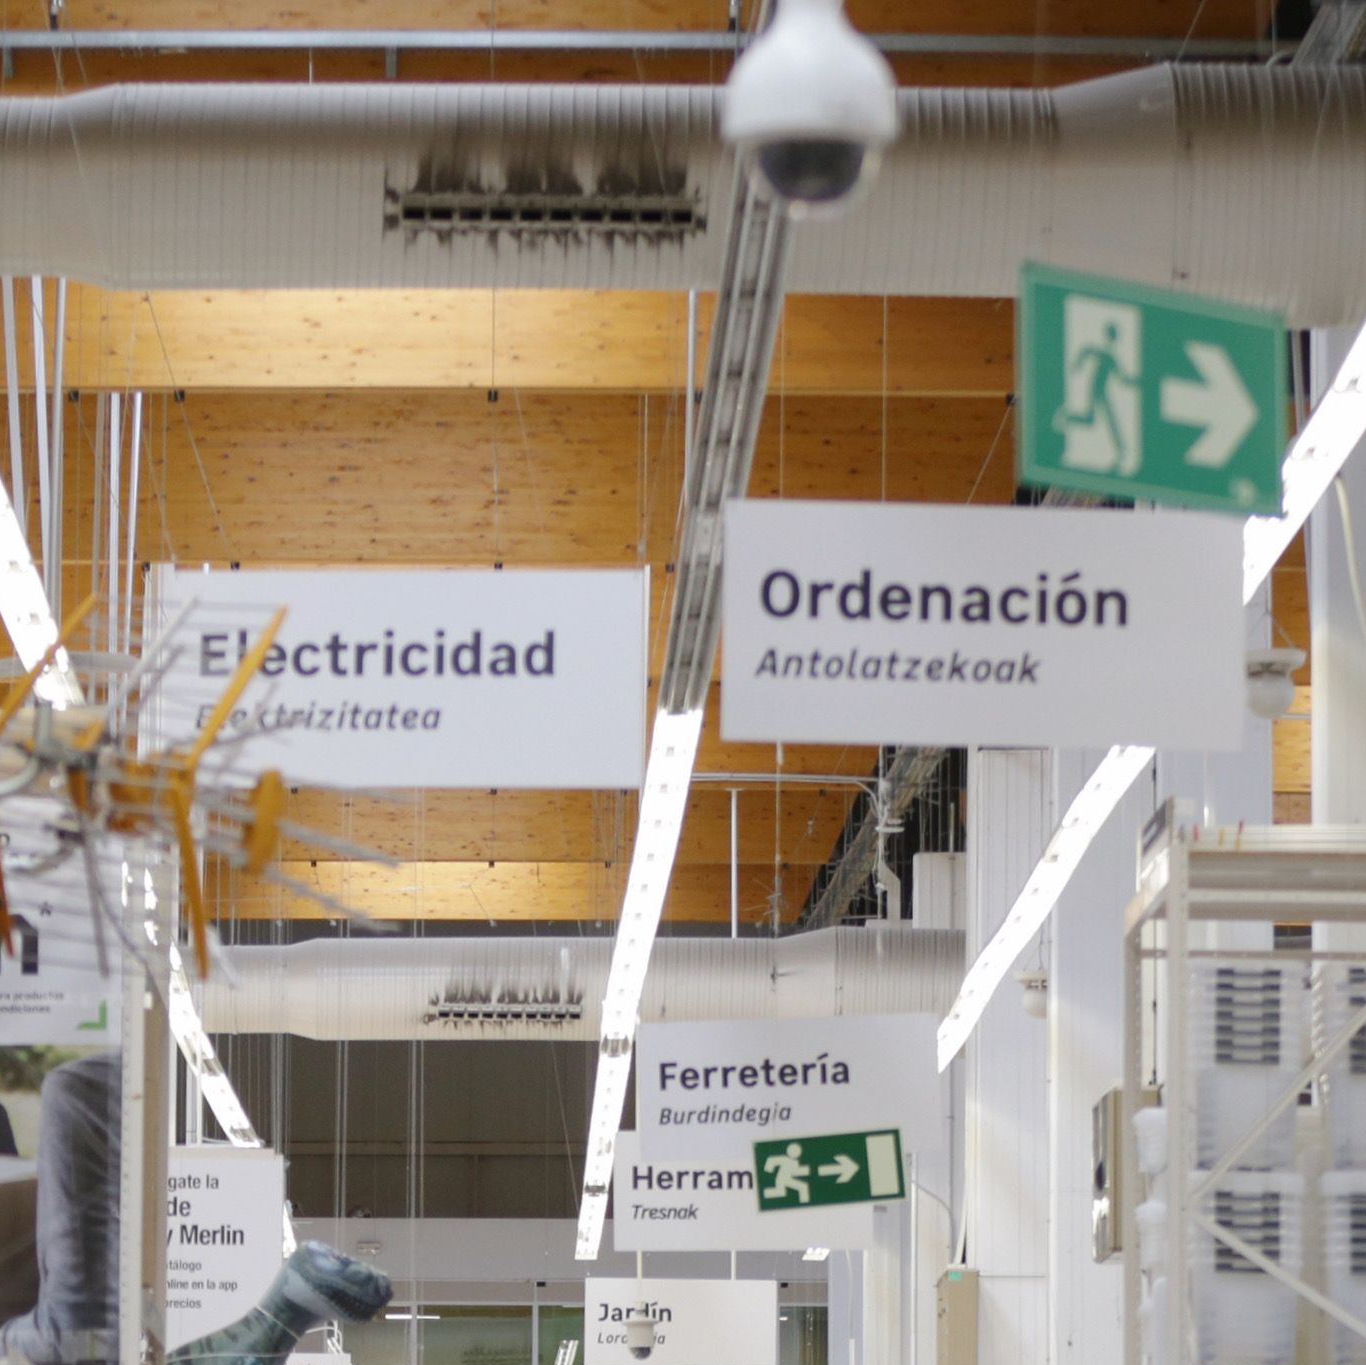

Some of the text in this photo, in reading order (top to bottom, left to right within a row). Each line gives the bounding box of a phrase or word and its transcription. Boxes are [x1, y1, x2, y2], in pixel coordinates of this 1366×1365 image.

[759, 569, 1128, 628] Ordenación
[199, 629, 556, 676] Electricidad
[755, 647, 1040, 685] Antolatzekoak
[195, 701, 441, 731] Eektrizitatea
[13, 991, 64, 1002] productos
[659, 1053, 850, 1091] Ferretería
[659, 1103, 792, 1127] Burdindegia
[206, 1174, 219, 1190] la
[632, 1165, 753, 1190] Herram
[632, 1204, 698, 1220] Tresnak
[180, 1224, 244, 1246] Merlin
[166, 1259, 202, 1272] tálogo
[191, 1282, 204, 1290] en
[206, 1279, 216, 1290] la
[218, 1282, 238, 1292] app
